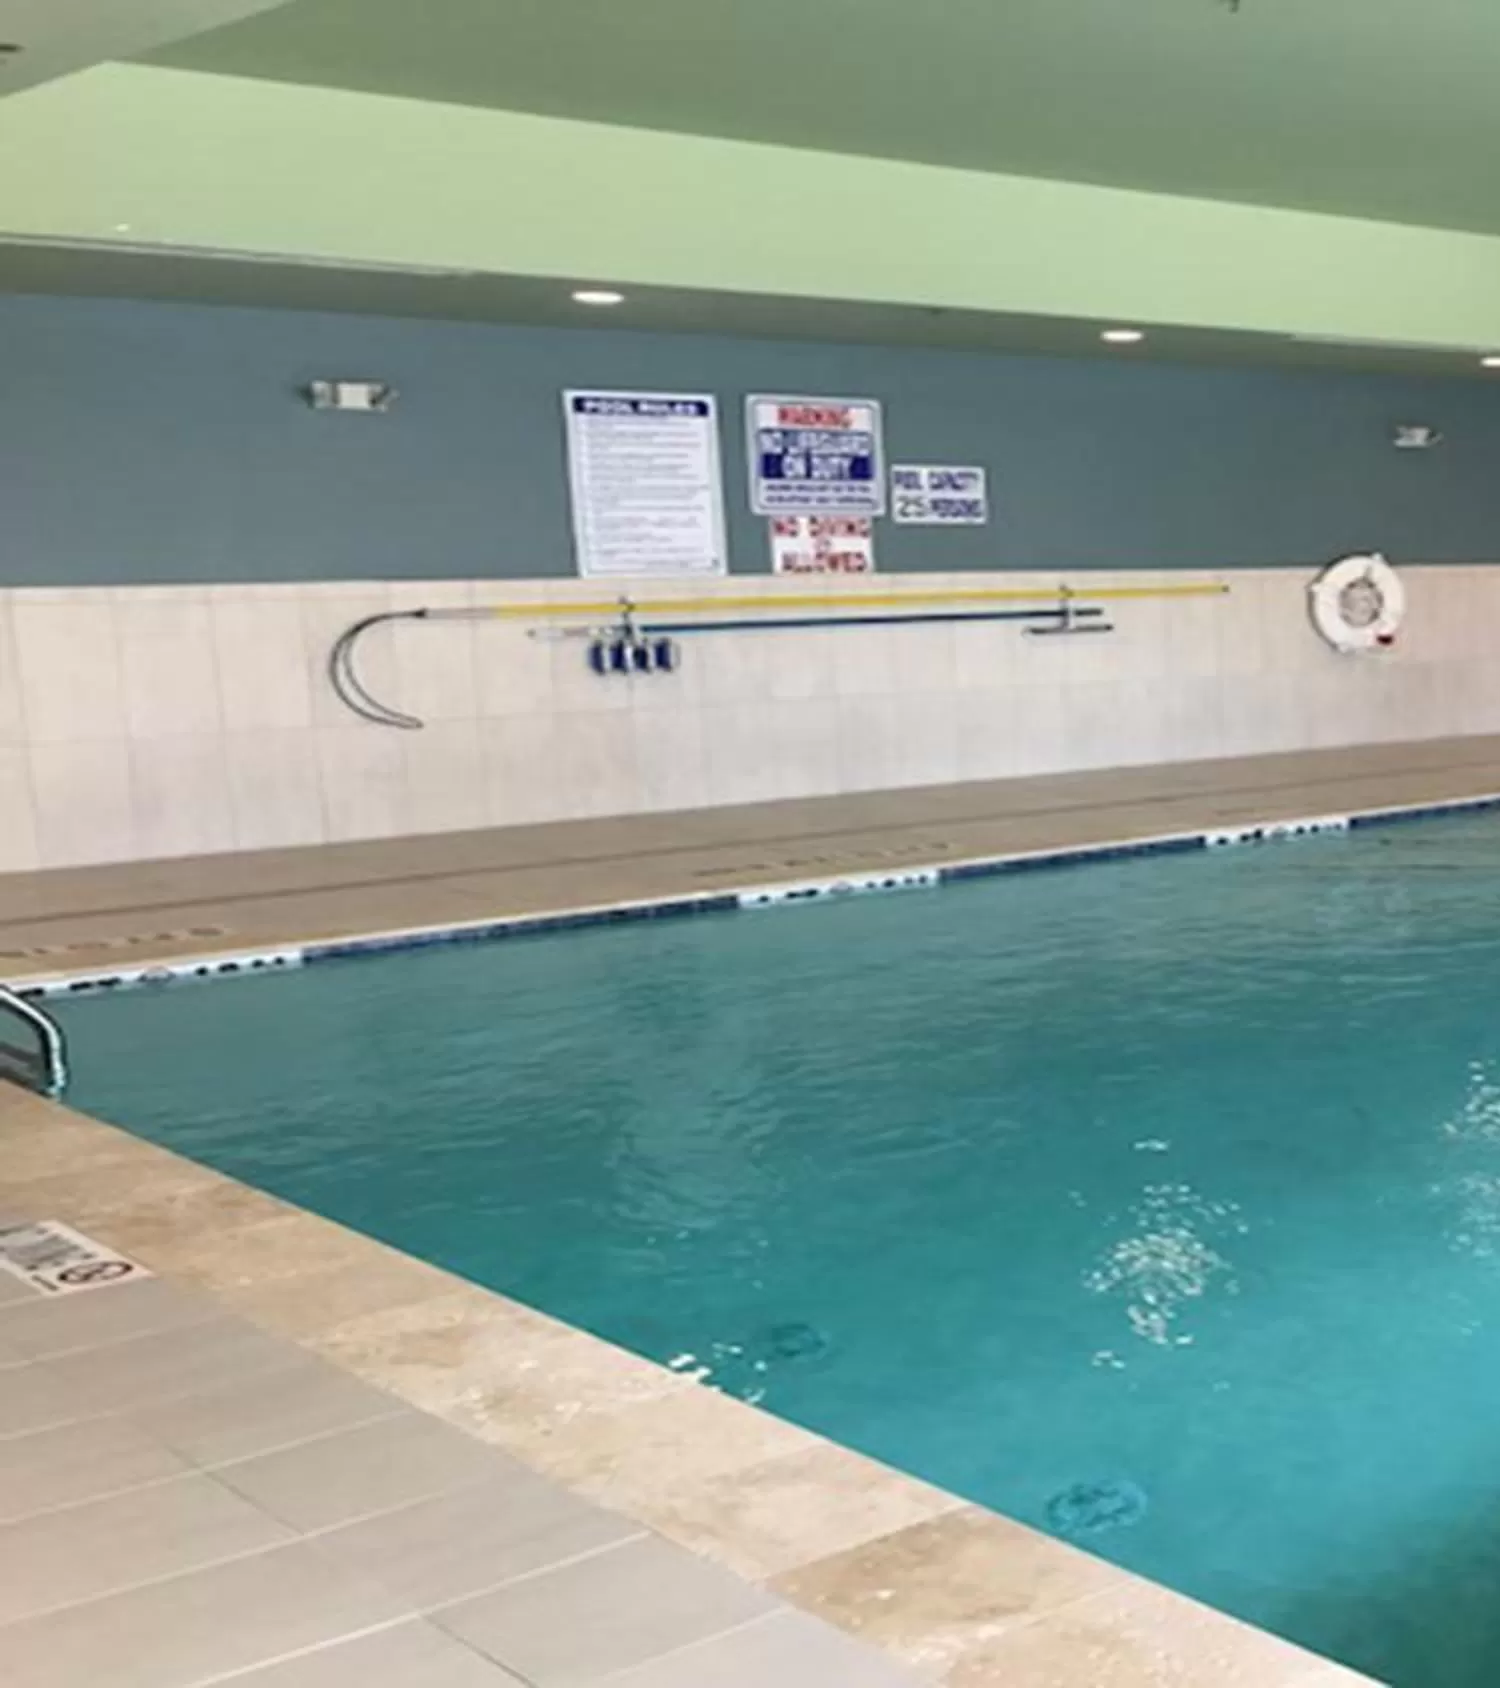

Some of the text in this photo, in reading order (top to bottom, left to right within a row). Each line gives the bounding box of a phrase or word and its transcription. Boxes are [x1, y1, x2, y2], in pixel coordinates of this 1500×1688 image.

[778, 406, 852, 428] WARNING
[759, 432, 870, 455] NO LIFEGUARD
[782, 455, 851, 478] ON DUTY
[898, 496, 926, 517] 25
[774, 516, 869, 538] NO DIVING
[782, 551, 866, 571] ALLOWED
